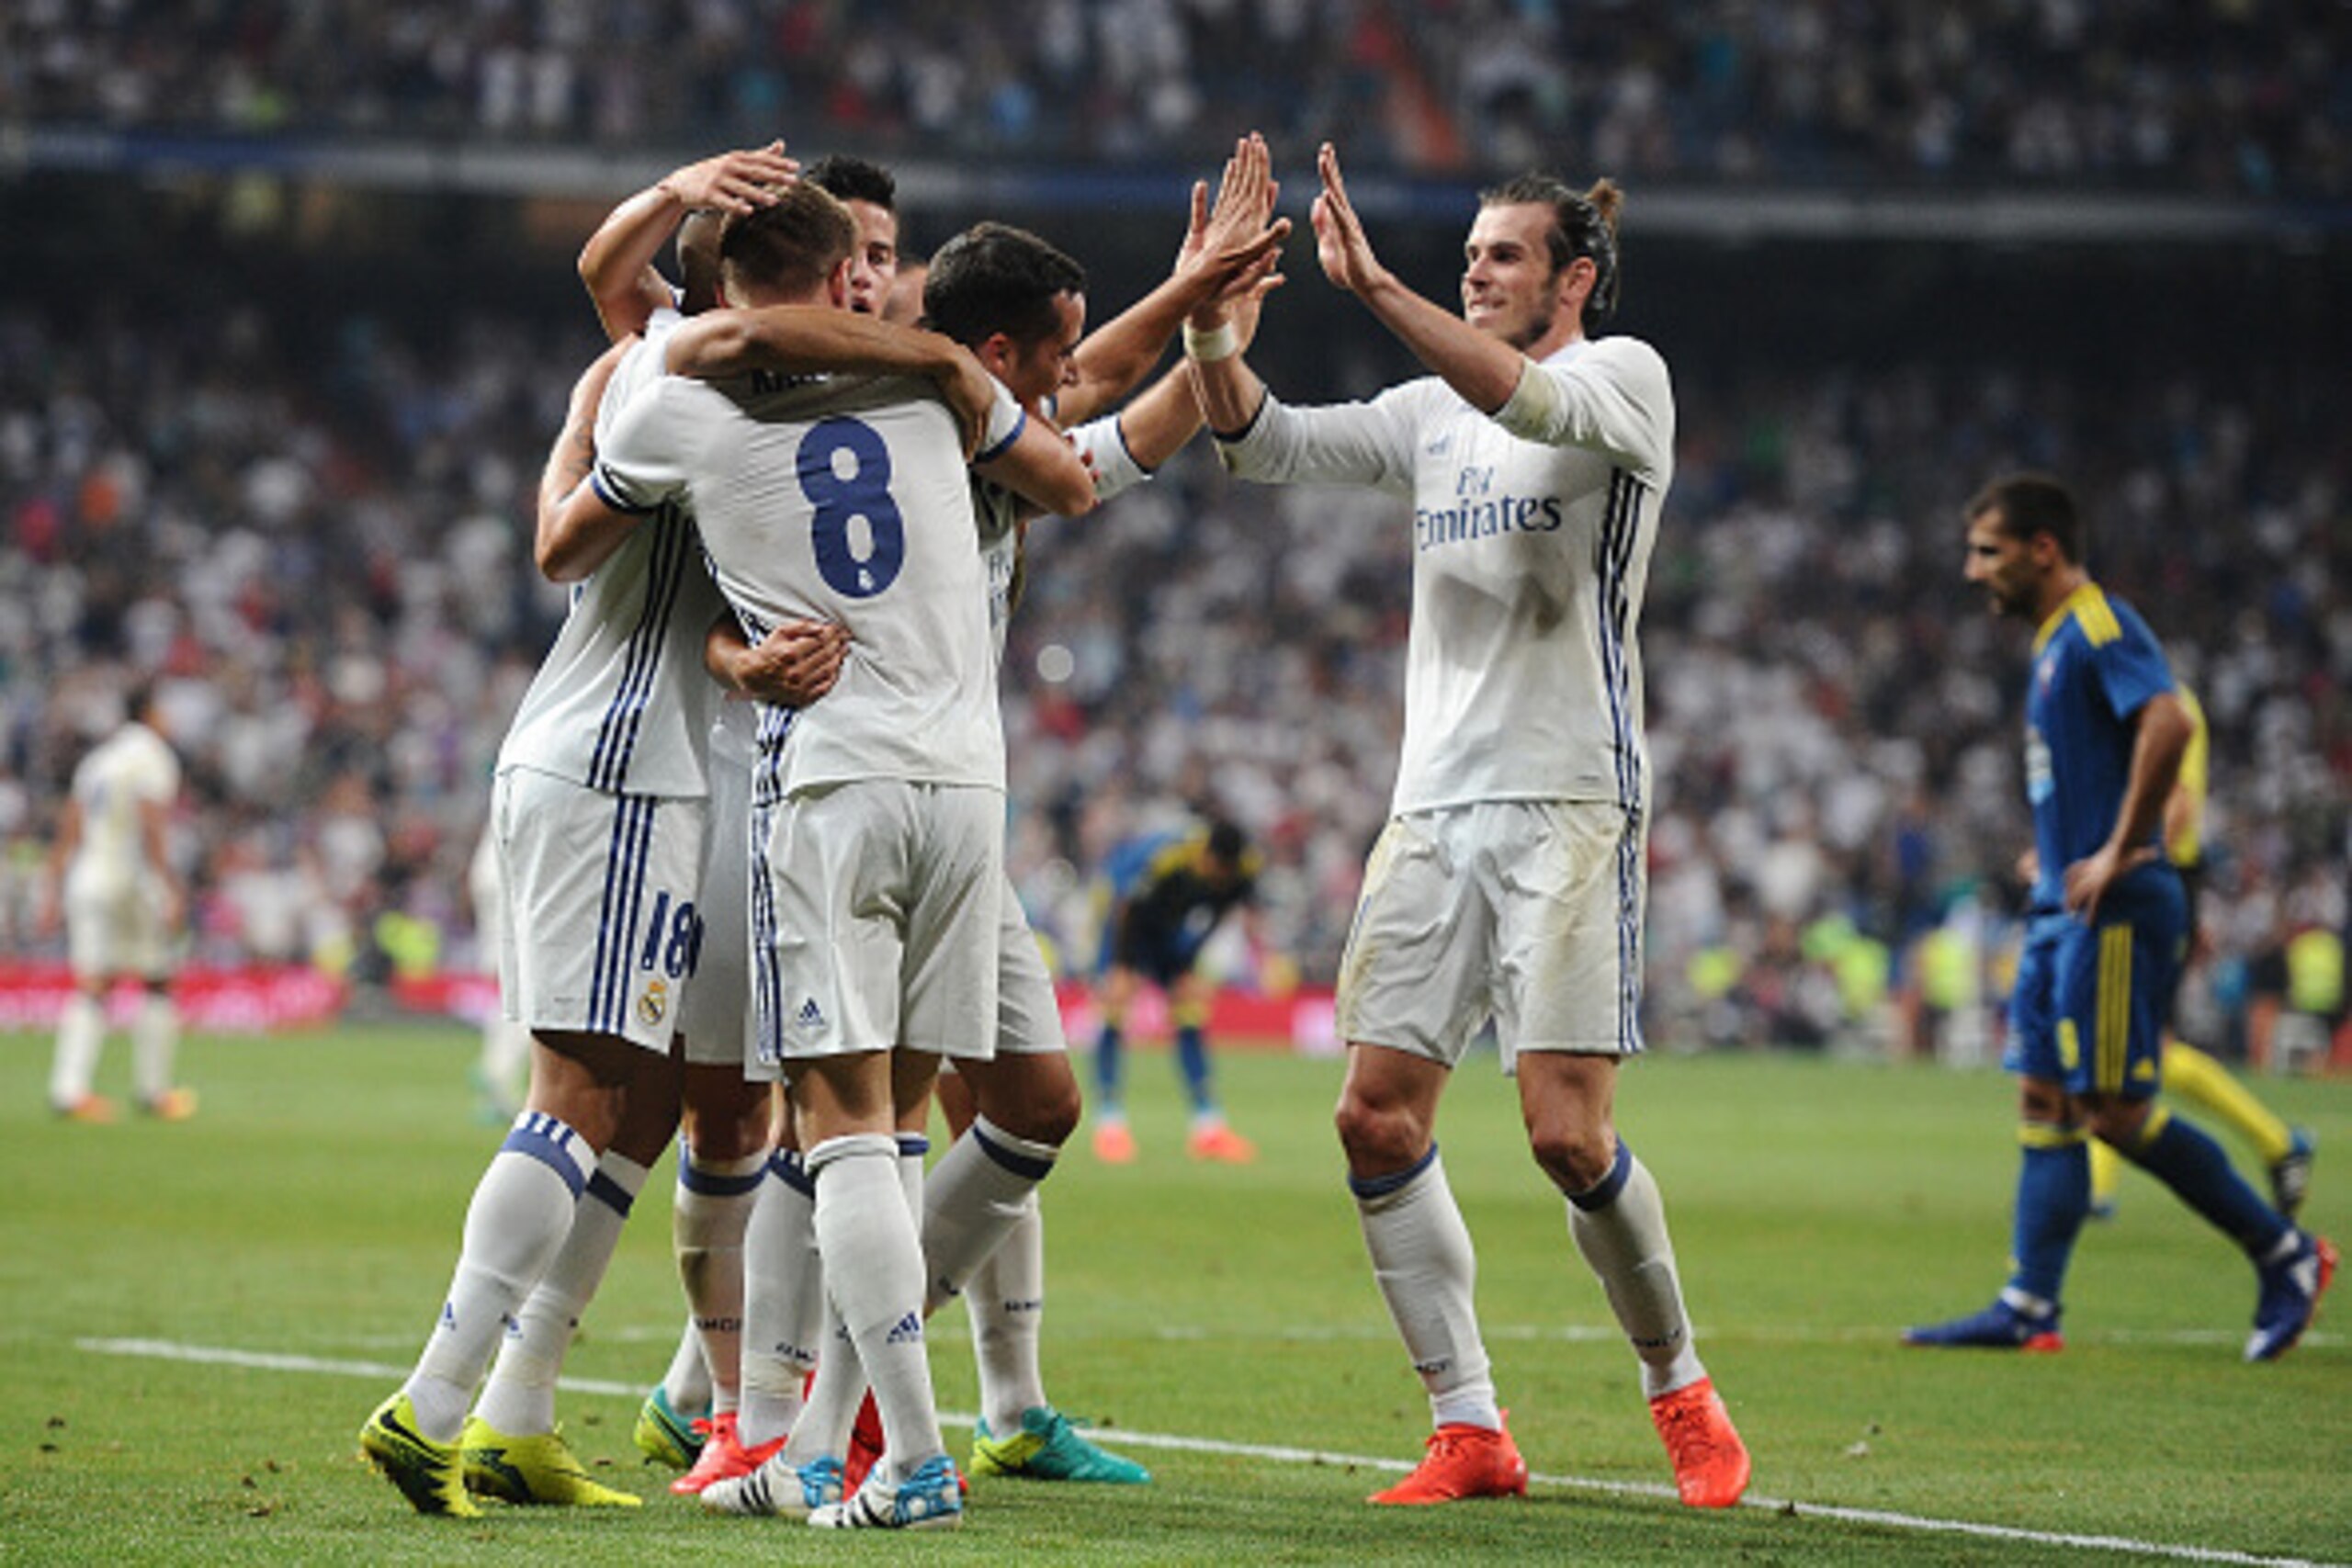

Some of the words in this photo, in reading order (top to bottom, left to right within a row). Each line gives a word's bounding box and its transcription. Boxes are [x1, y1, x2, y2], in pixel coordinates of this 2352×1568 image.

[796, 416, 905, 598] 8
[1417, 495, 1561, 551] Emirates
[641, 891, 699, 979] 18
